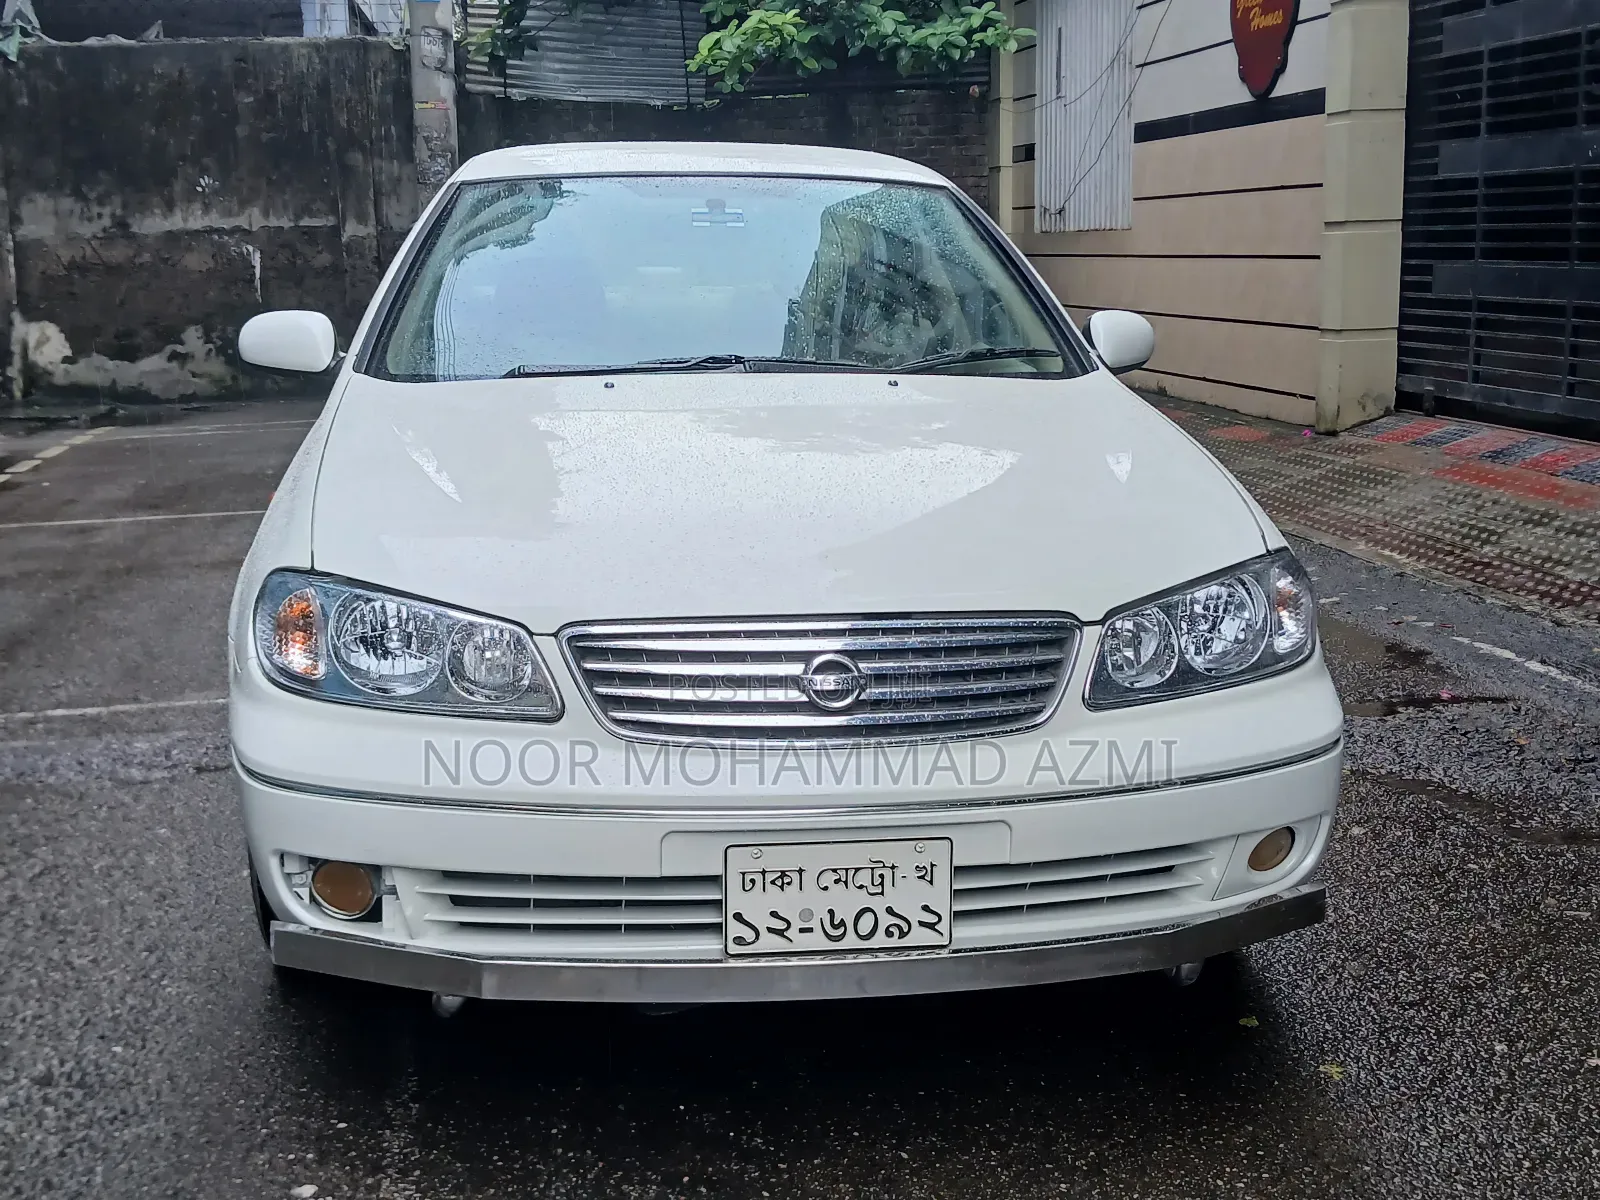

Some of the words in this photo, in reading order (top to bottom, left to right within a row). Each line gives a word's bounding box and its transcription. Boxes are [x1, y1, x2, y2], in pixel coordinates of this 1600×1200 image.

[1249, 7, 1284, 31] Homes
[738, 866, 807, 893] ঢাকা
[731, 903, 944, 947] ১২-৬০৯২
